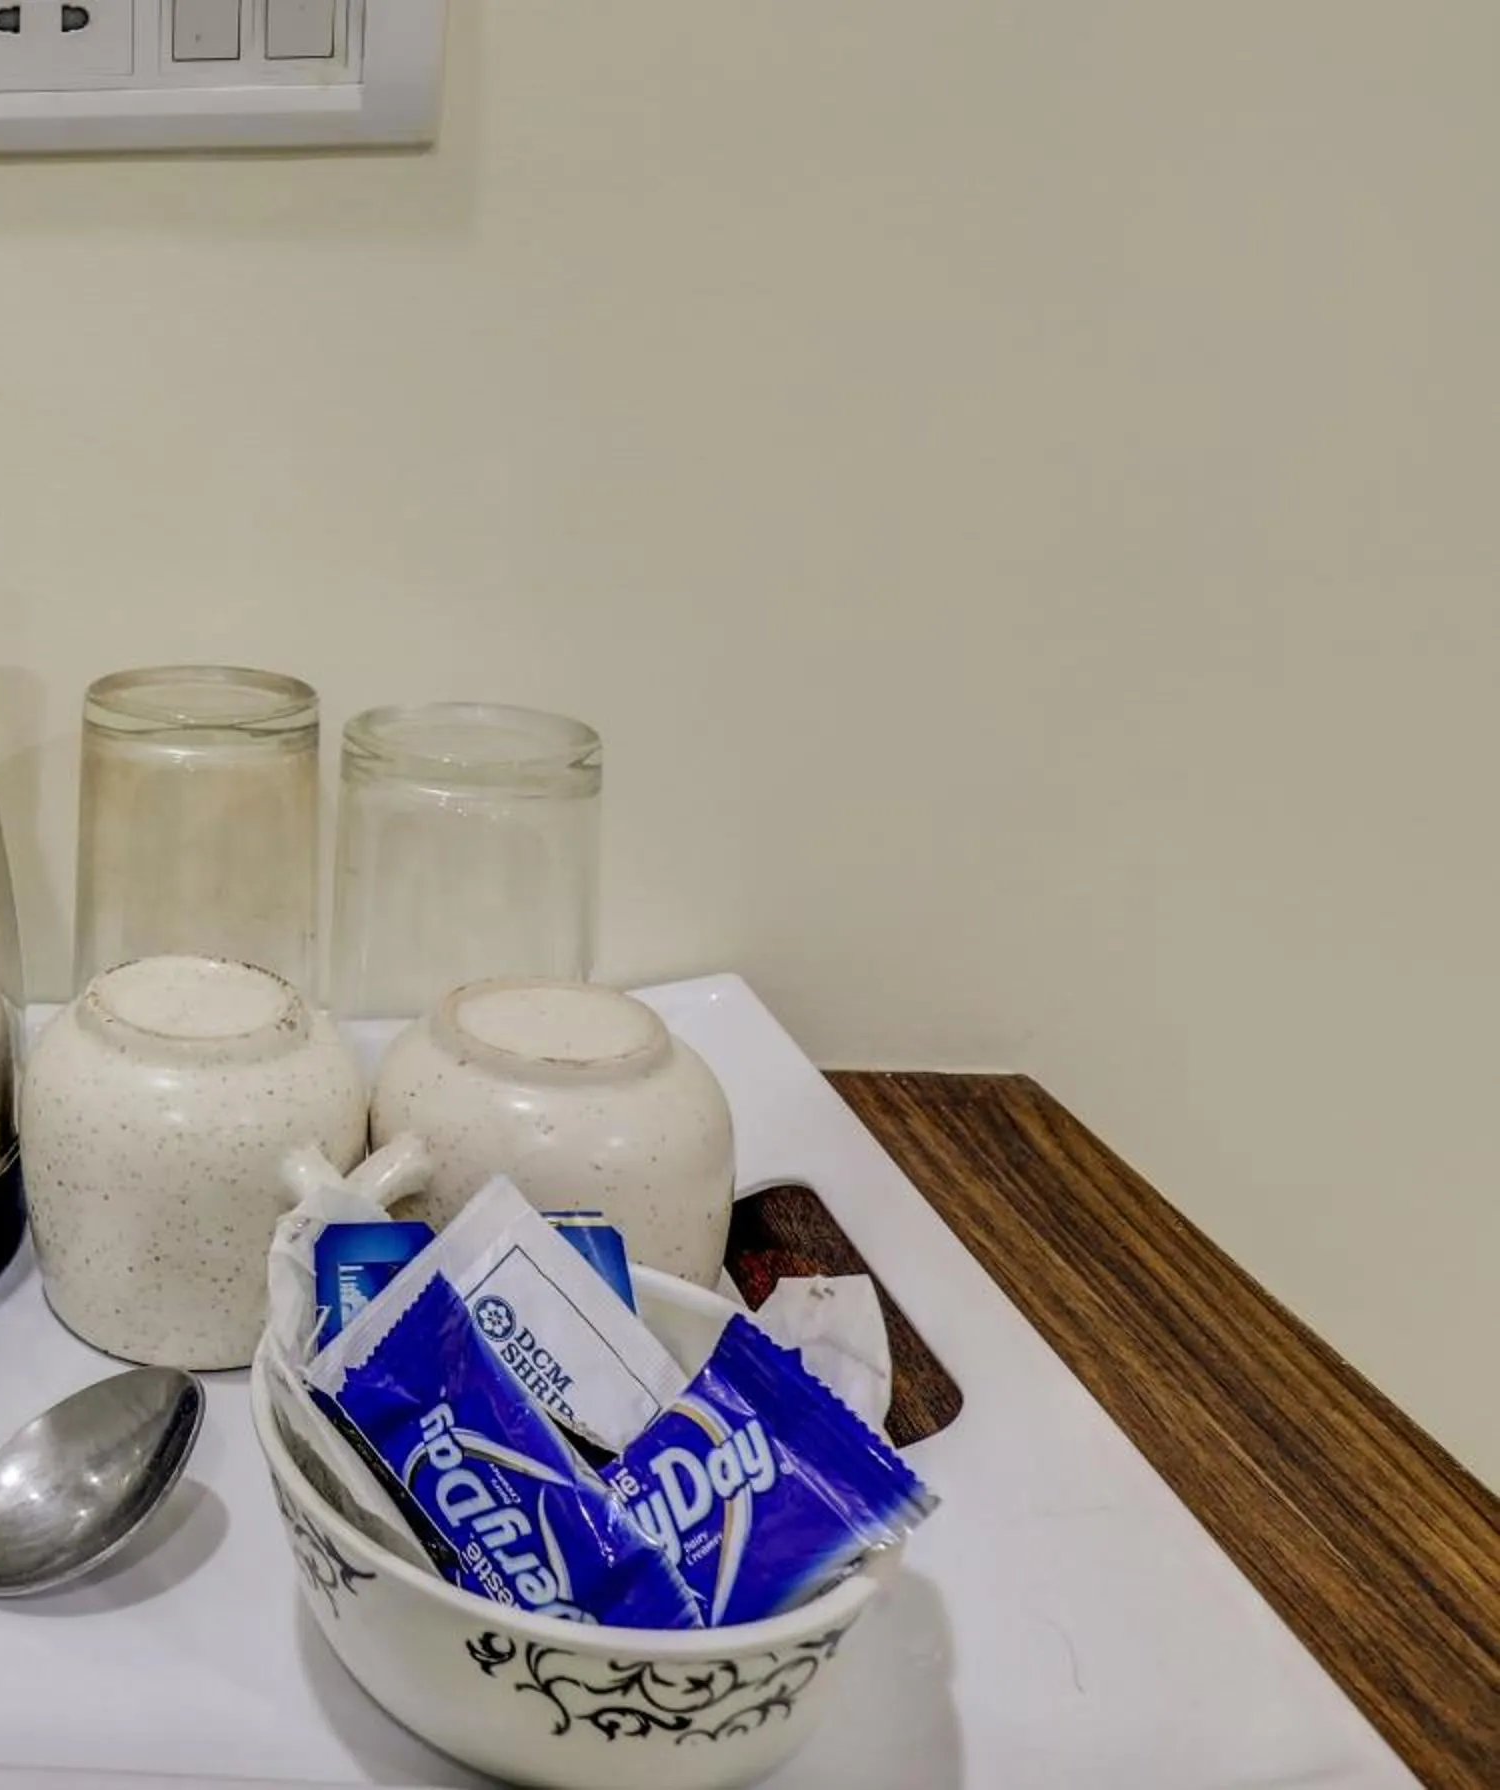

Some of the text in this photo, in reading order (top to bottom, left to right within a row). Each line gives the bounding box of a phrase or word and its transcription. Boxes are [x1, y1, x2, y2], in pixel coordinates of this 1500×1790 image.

[514, 1326, 576, 1395] DCM
[419, 1402, 599, 1625] eryDay
[632, 1418, 776, 1566] yDay
[462, 1540, 521, 1608] estlé
